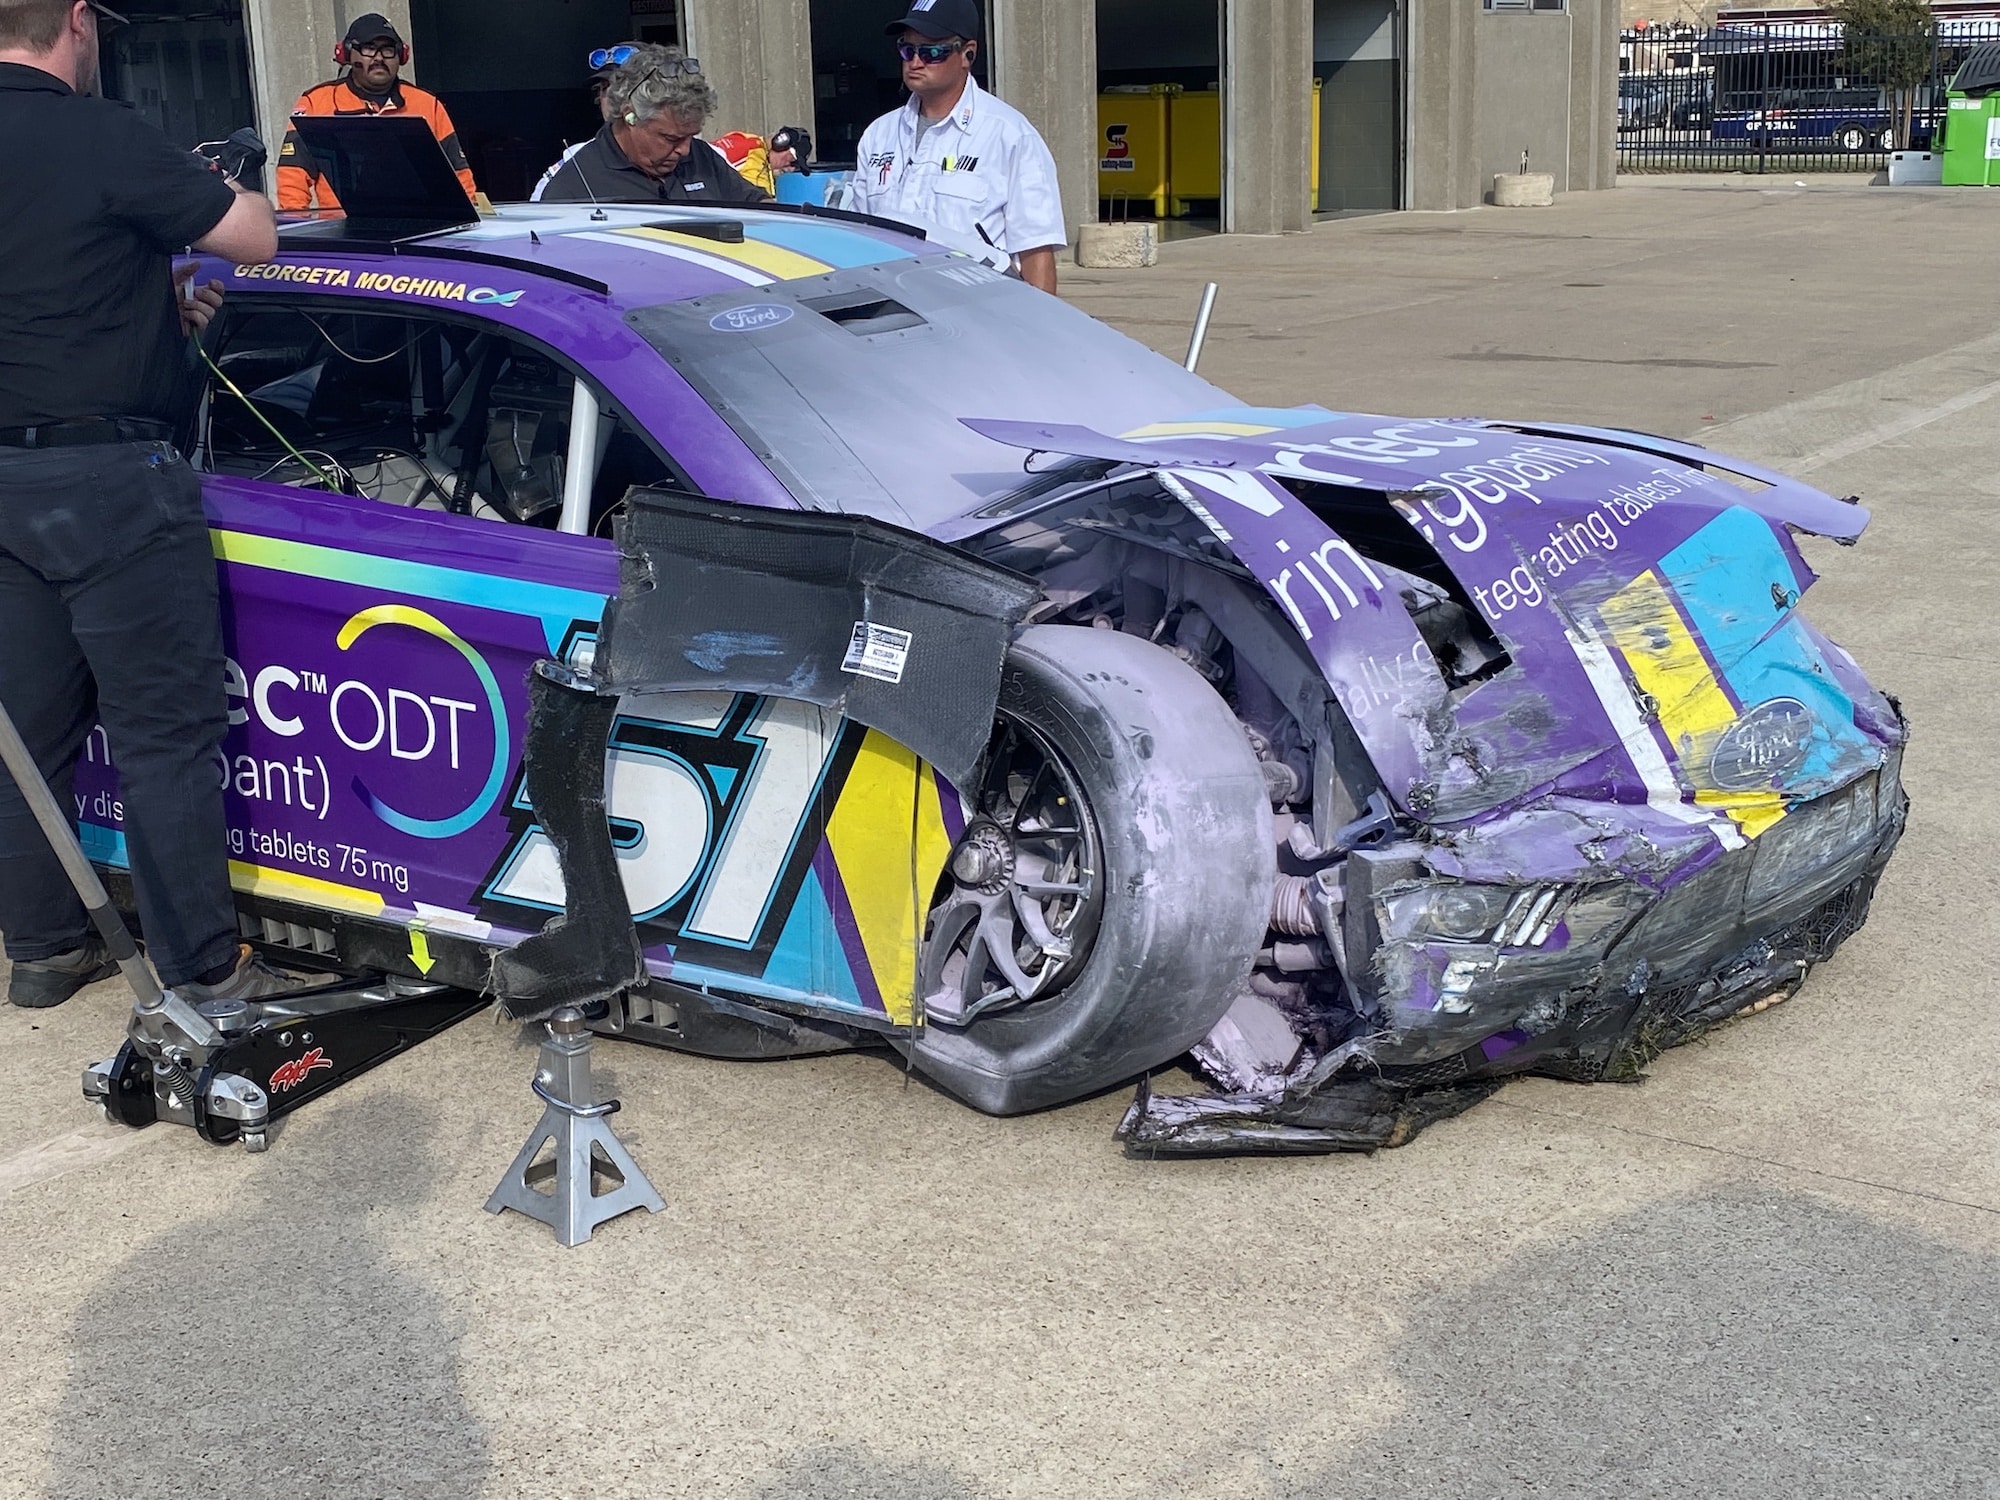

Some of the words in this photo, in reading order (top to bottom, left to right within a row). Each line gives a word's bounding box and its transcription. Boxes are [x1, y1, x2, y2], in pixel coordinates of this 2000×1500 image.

[234, 263, 350, 288] GEORGETA
[354, 271, 467, 301] MOGHINA
[726, 307, 781, 328] Ford
[1473, 510, 1619, 621] tegating
[329, 679, 477, 770] ODT
[249, 828, 331, 869] tablets
[336, 843, 368, 878] 75
[372, 858, 409, 893] mg
